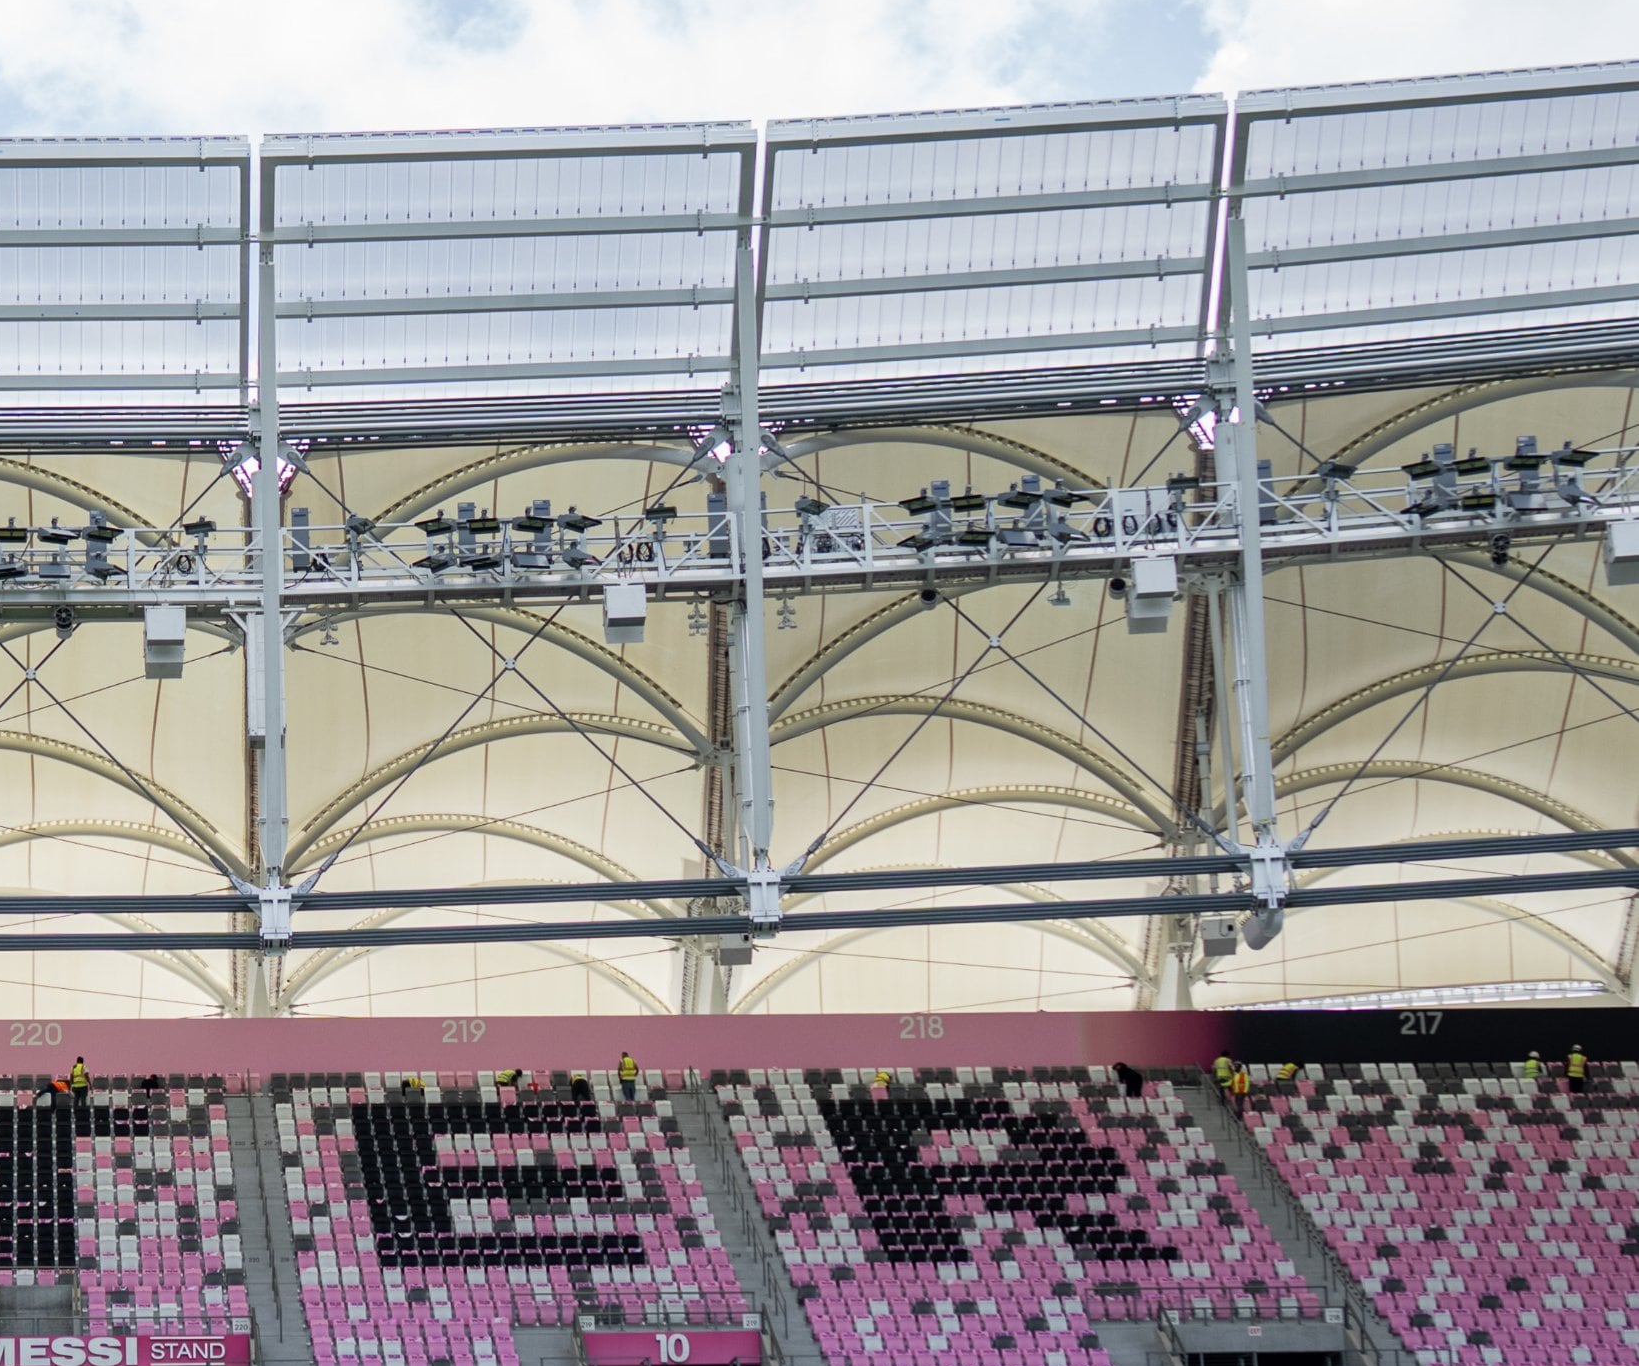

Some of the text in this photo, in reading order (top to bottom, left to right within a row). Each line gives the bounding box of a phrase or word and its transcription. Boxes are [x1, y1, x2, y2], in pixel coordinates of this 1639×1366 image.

[9, 1022, 64, 1047] 220
[441, 1019, 487, 1044] 219
[898, 1015, 945, 1040] 218
[1399, 1011, 1444, 1035] 217
[234, 1324, 248, 1332] 220
[150, 1342, 226, 1360] STAND
[655, 1333, 690, 1363] 10
